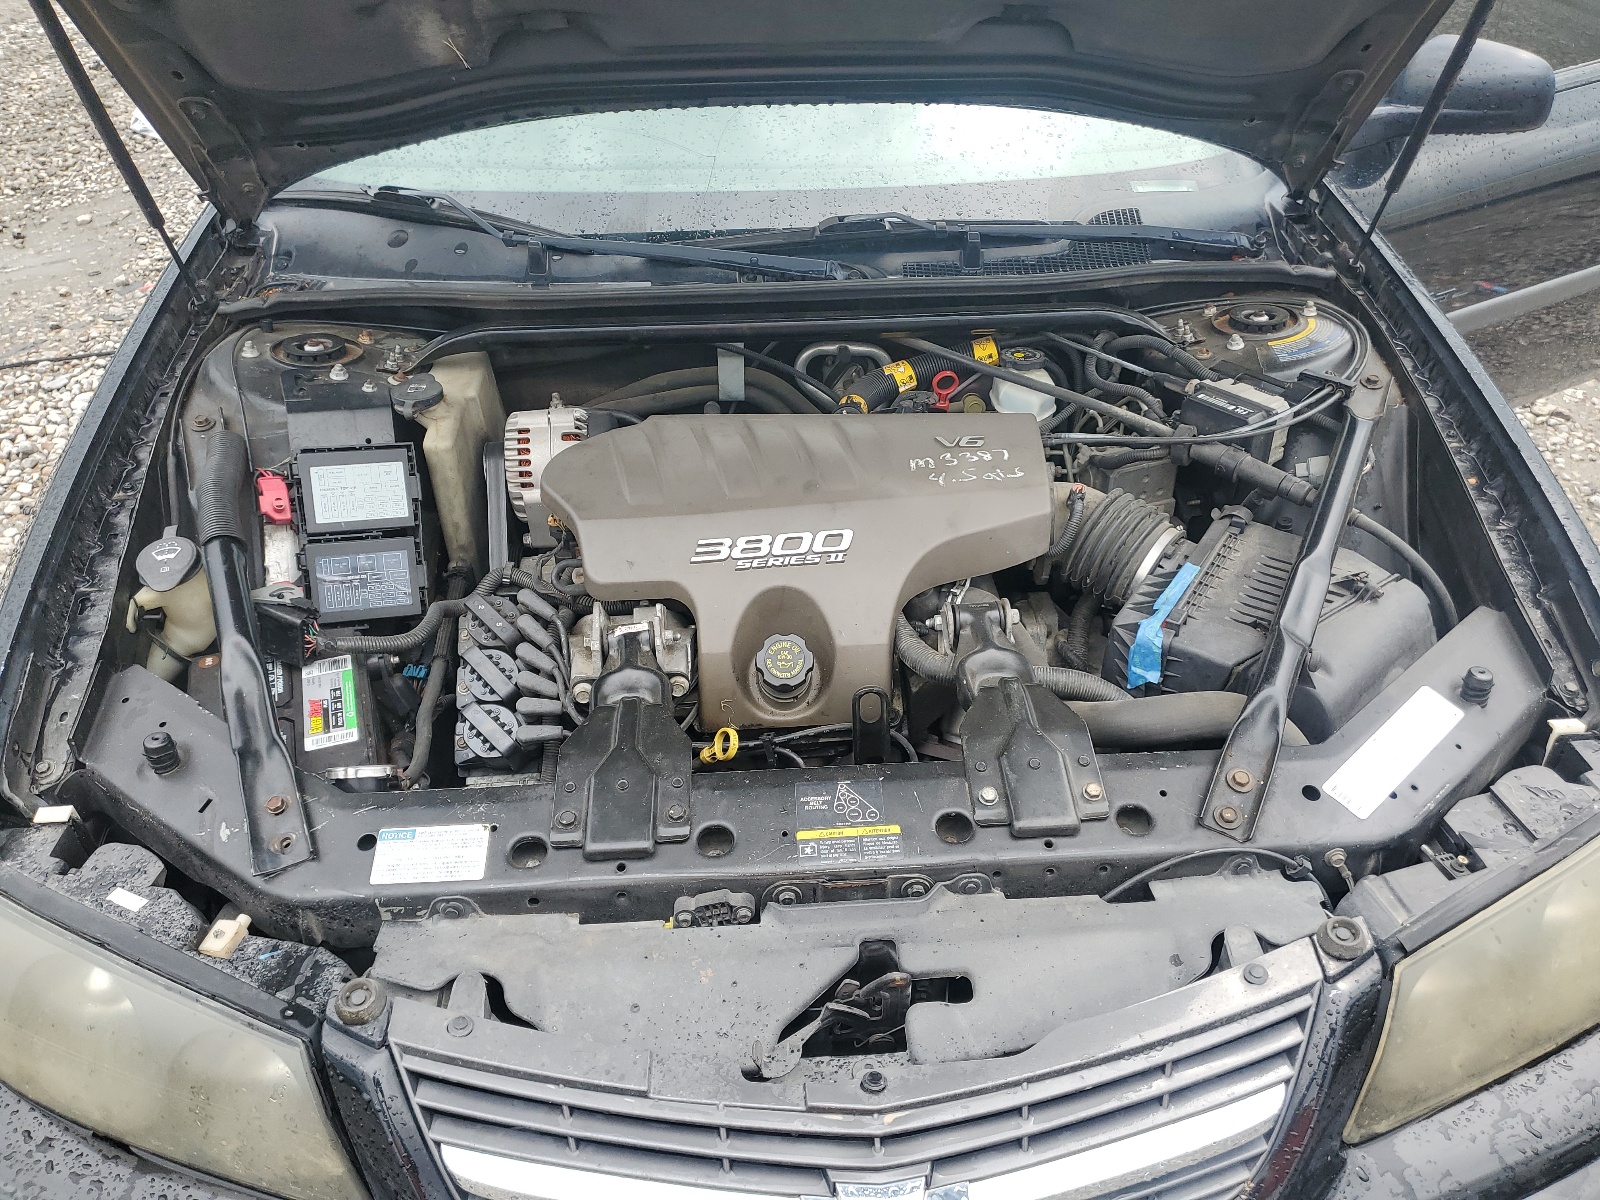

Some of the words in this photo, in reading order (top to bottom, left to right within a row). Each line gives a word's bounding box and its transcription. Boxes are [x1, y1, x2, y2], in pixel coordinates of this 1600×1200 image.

[934, 435, 985, 448] V6
[690, 528, 854, 564] 3800
[735, 554, 821, 571] SERIES
[825, 553, 847, 564] II
[768, 641, 792, 655] ENGINE
[791, 645, 801, 655] OIL
[307, 699, 323, 735] EverStart
[381, 831, 413, 840] NOTICE
